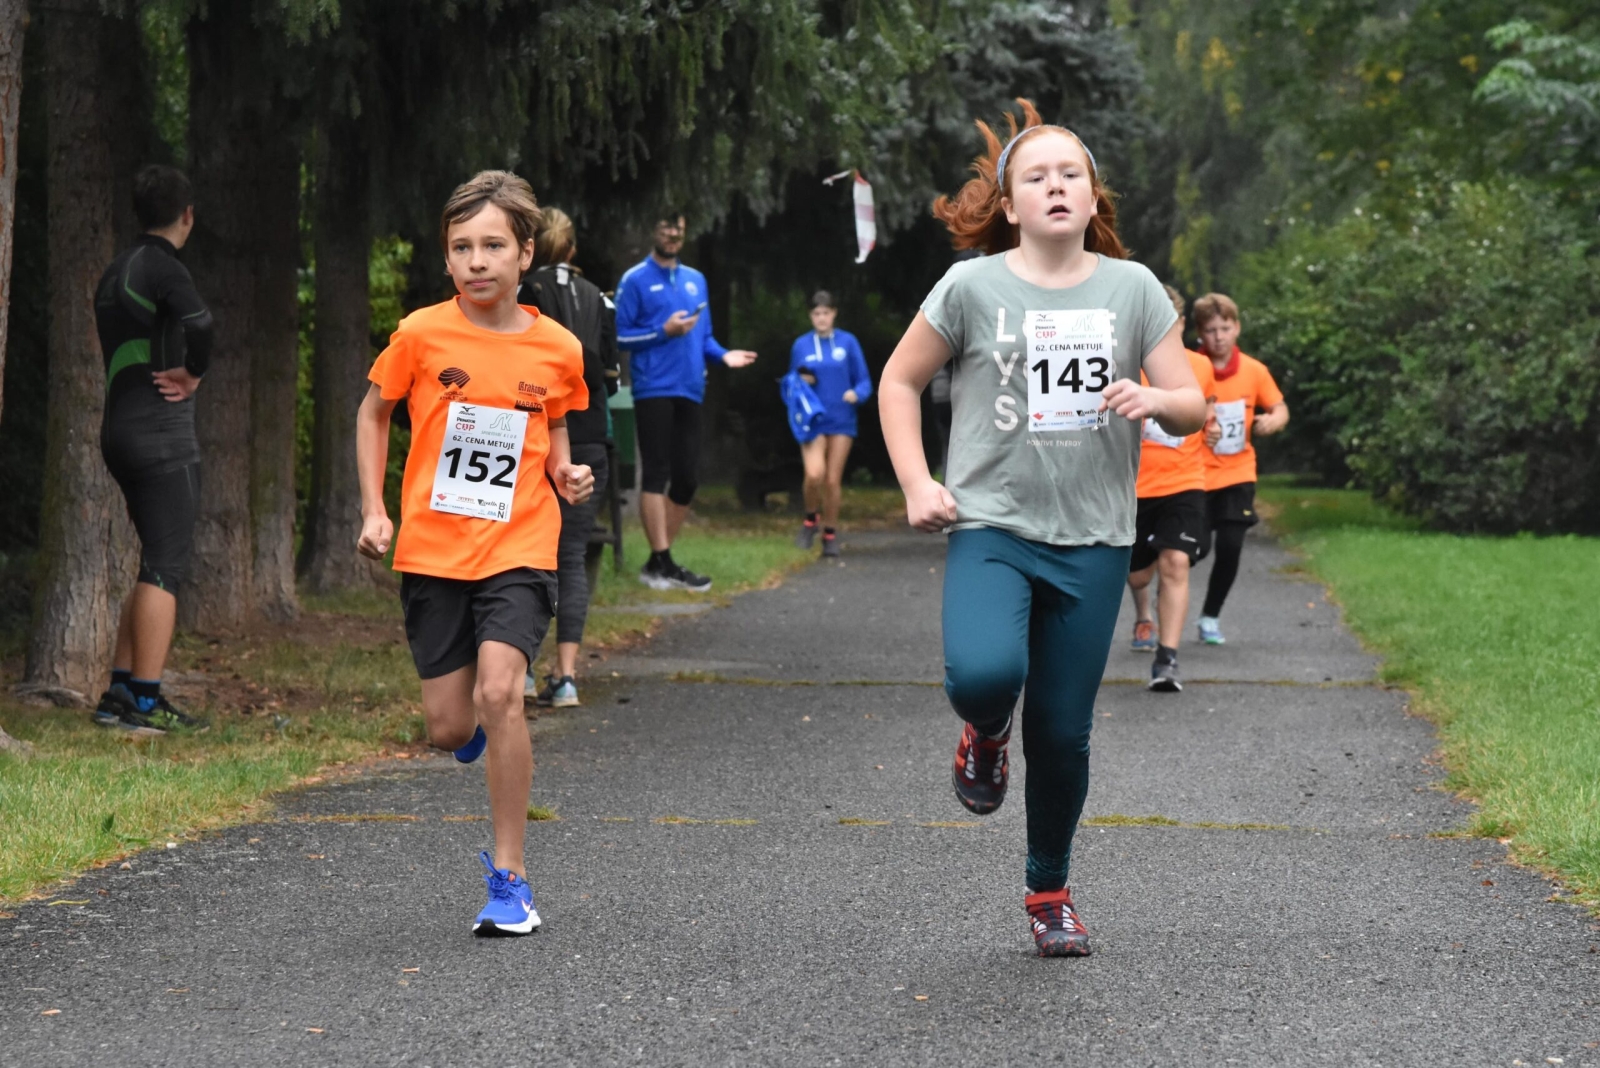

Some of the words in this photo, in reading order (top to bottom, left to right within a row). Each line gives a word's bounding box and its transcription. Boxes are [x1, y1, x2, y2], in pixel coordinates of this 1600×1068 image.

[1035, 331, 1057, 339] CUP
[1035, 344, 1047, 352] 62.
[1049, 343, 1071, 351] CENA
[1073, 342, 1104, 351] METUJE
[1031, 356, 1110, 395] 143
[455, 422, 475, 432] CUP
[1220, 421, 1244, 438] 27
[452, 434, 463, 442] 62.
[465, 436, 486, 446] CENA
[487, 439, 516, 450] METUJE
[444, 447, 517, 489] 152
[498, 502, 506, 511] B
[497, 510, 505, 519] N
